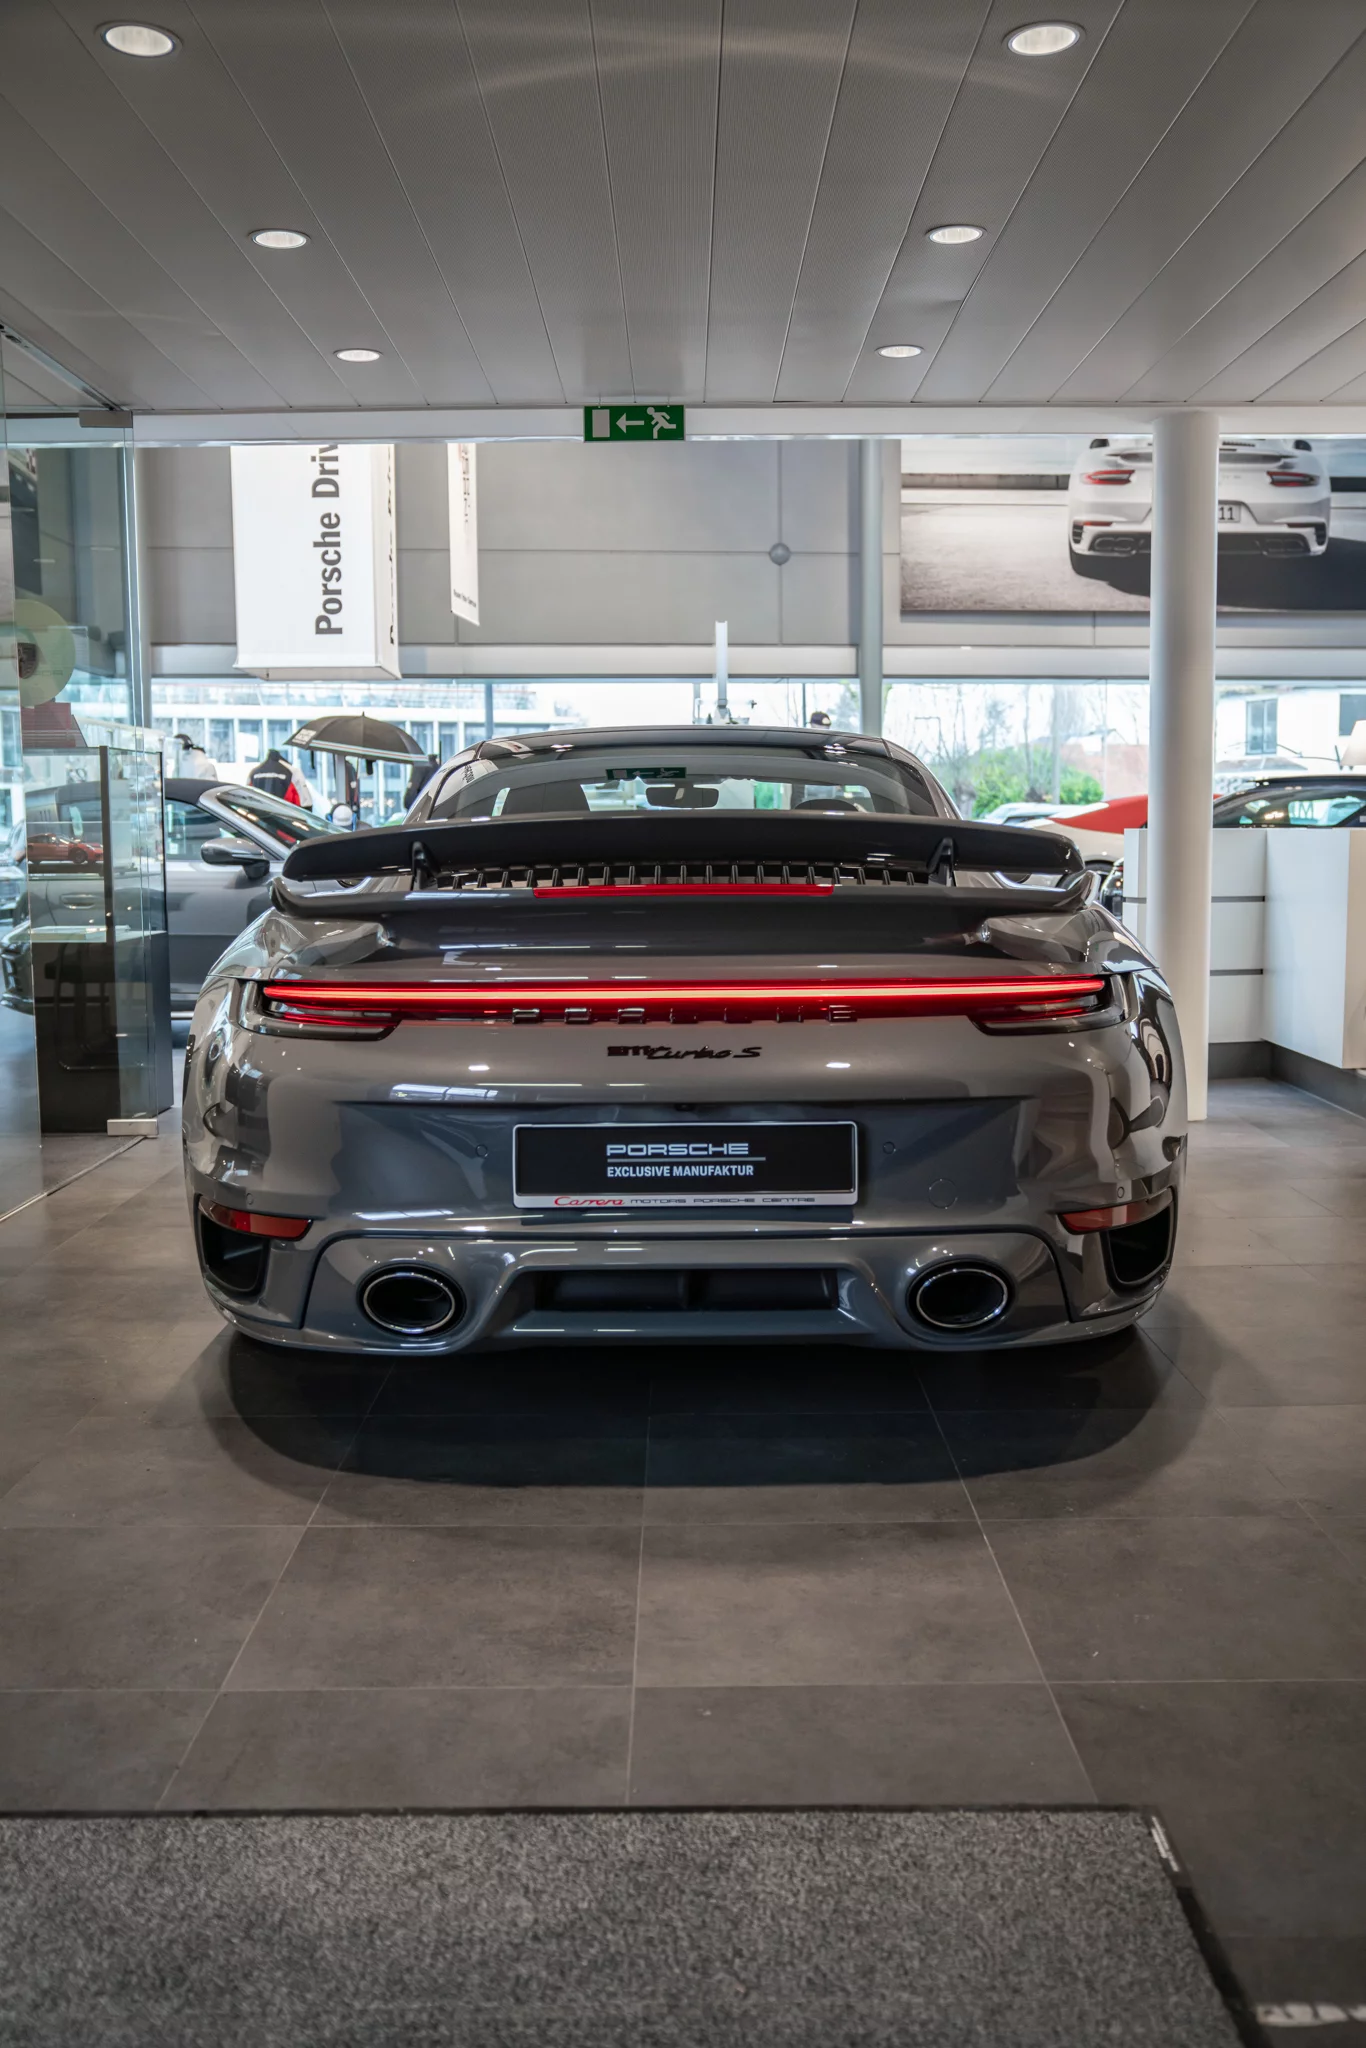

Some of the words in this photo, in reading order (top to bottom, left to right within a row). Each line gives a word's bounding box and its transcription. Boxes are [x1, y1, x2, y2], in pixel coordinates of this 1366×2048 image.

[313, 513, 342, 634] Porsche
[606, 1143, 749, 1156] PORSCHE
[606, 1165, 671, 1178] EXCLUSIVE
[672, 1164, 754, 1177] MANUFAKTUR
[554, 1195, 625, 1206] Carrera
